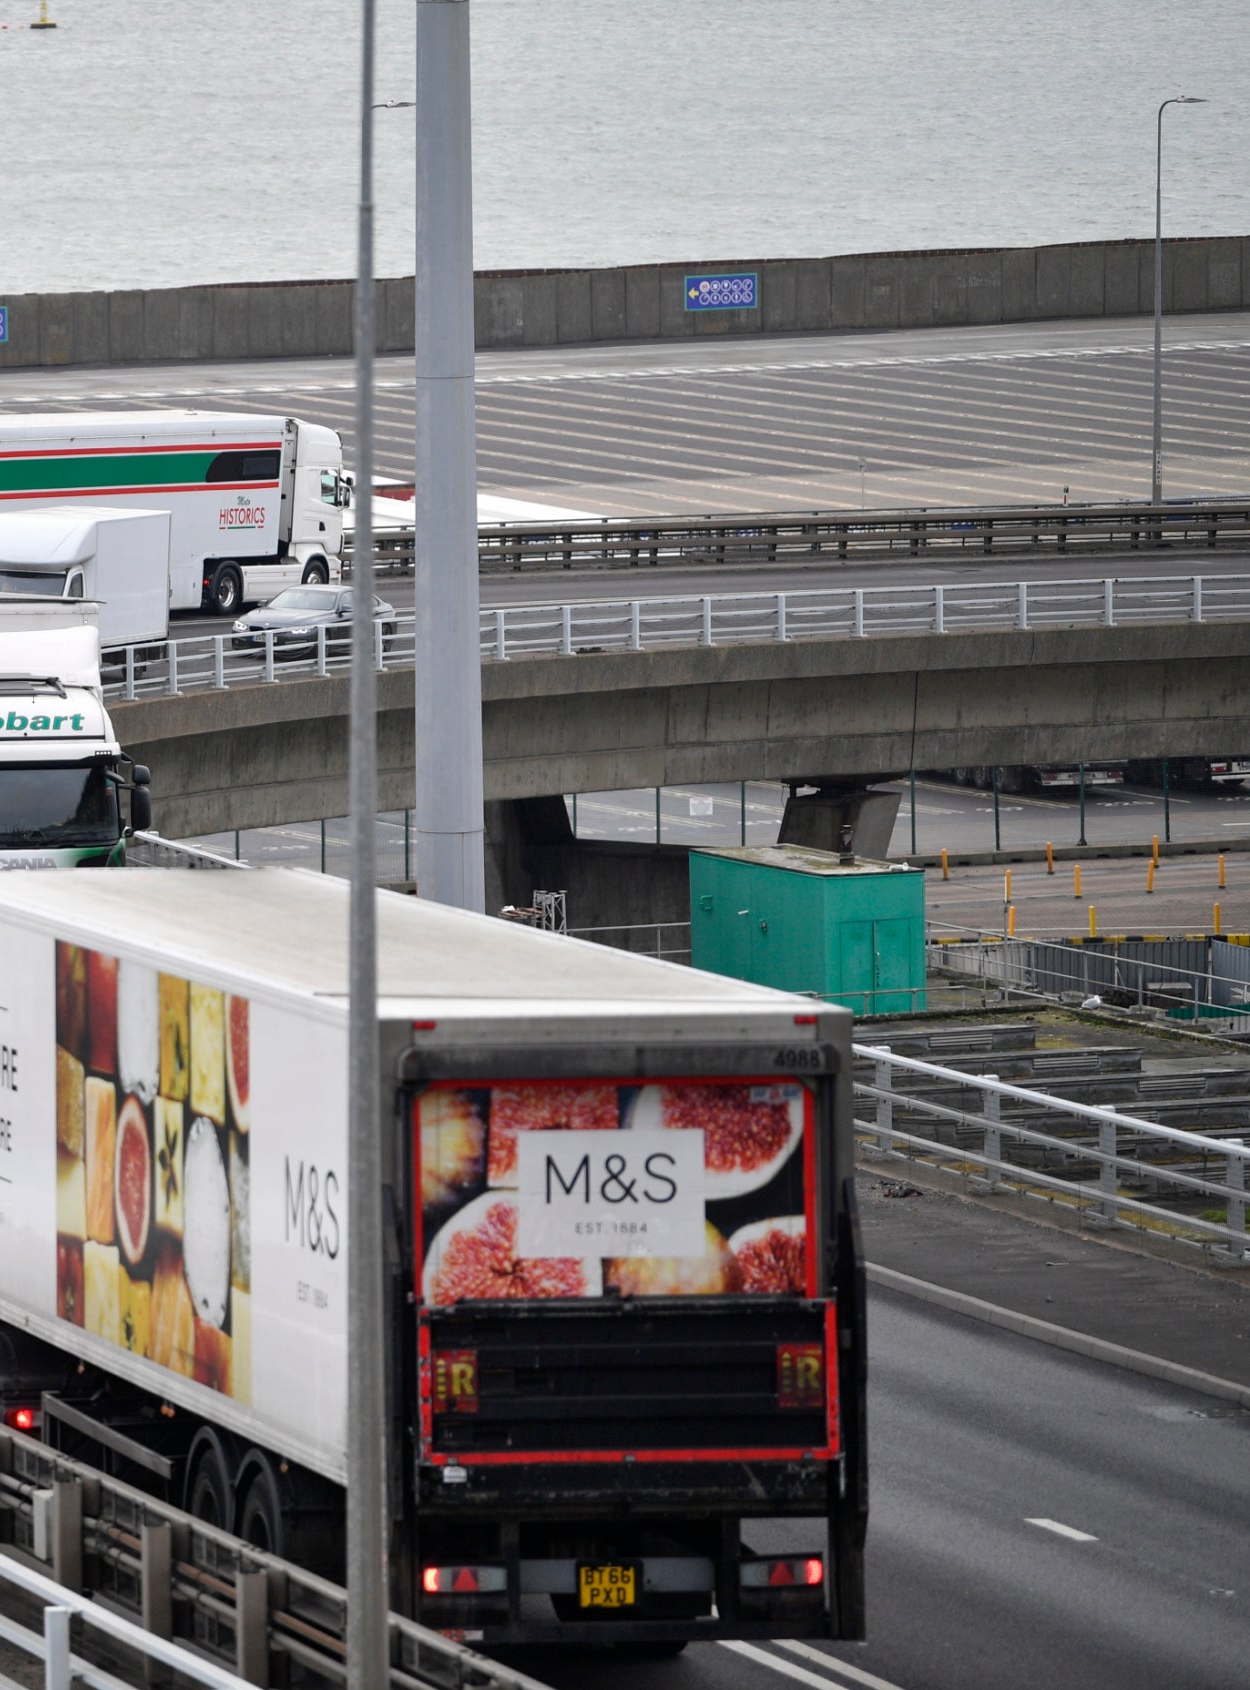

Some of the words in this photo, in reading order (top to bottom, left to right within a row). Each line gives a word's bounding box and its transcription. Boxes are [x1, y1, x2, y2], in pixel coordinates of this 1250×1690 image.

[219, 507, 266, 525] HISTORICS
[546, 1153, 678, 1205] M&S
[284, 1153, 341, 1260] M&S
[612, 1222, 648, 1234] 1884
[584, 1568, 631, 1585] BT66
